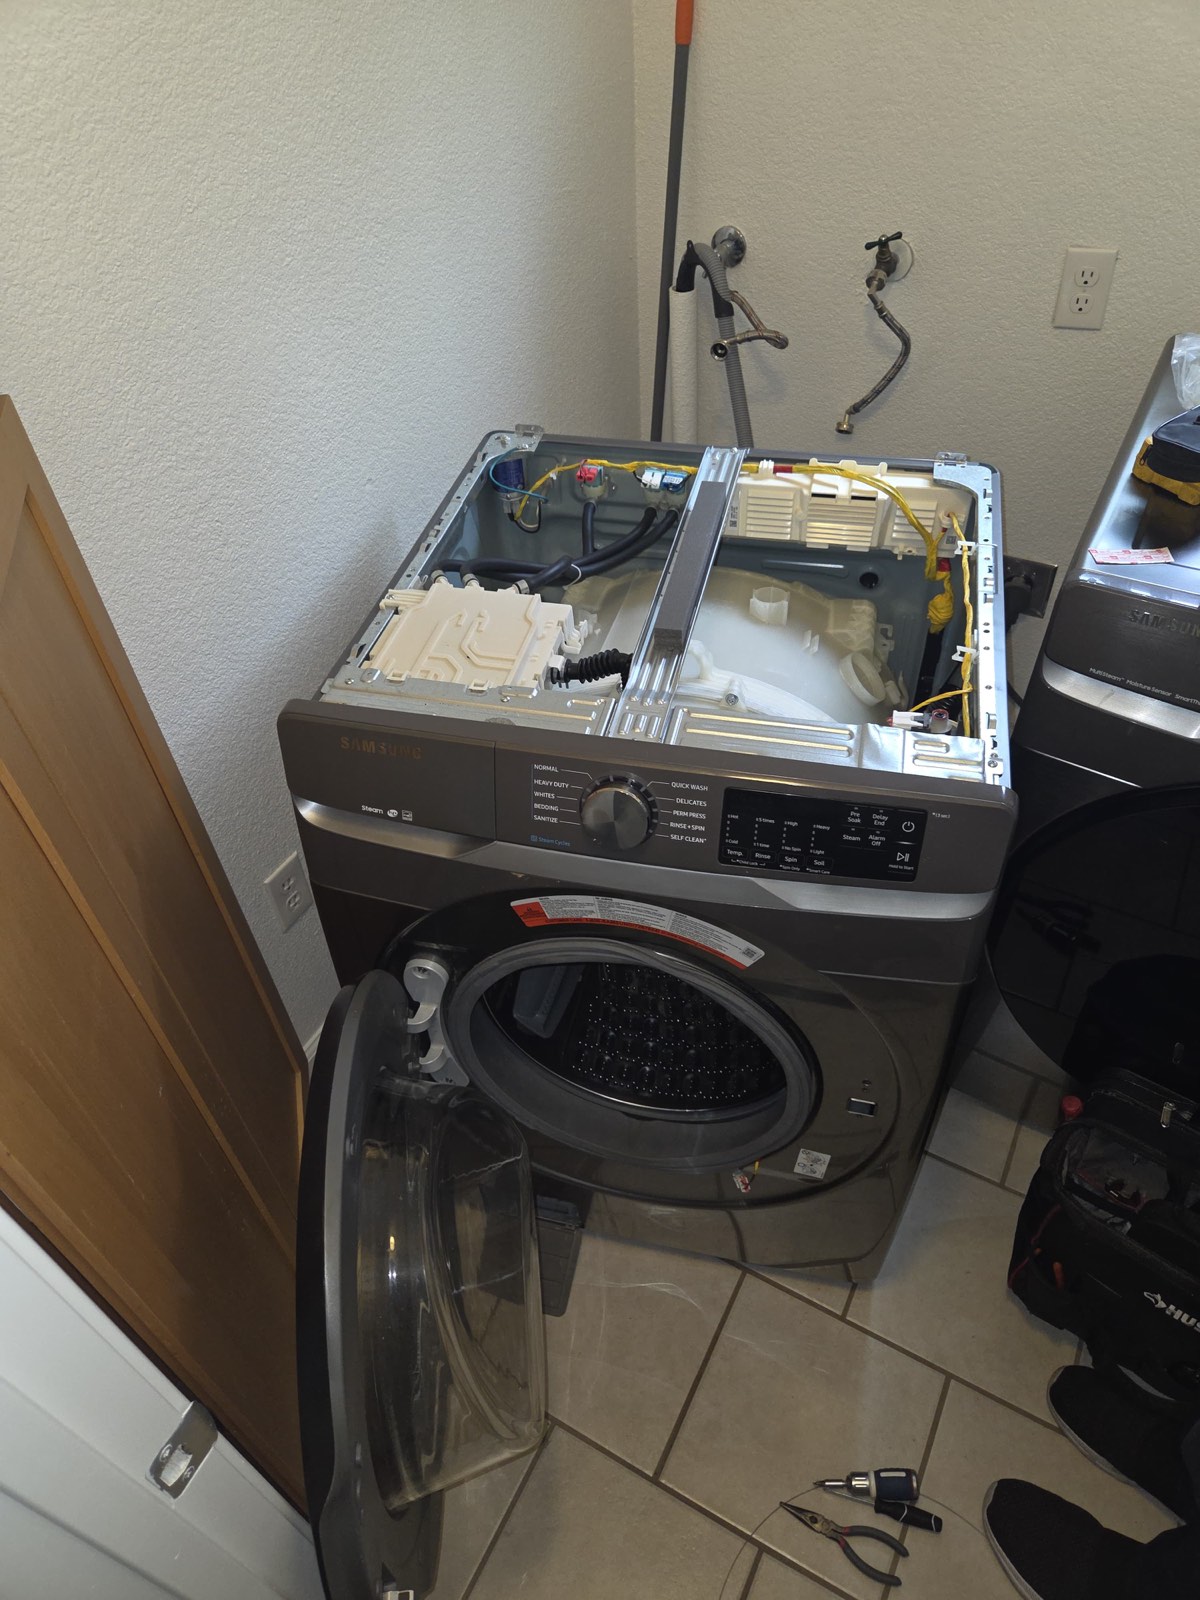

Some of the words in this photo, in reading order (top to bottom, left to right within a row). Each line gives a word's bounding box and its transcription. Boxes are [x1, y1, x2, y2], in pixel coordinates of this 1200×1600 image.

[1126, 680, 1151, 692] Moisture
[1151, 686, 1172, 698] Sensor
[339, 736, 422, 760] SAMSUNG
[534, 764, 559, 773] NORMAL
[534, 779, 553, 787] HEAVY
[554, 781, 570, 789] DUTY
[671, 781, 690, 790] QUICK
[690, 784, 708, 792] WASH
[534, 791, 555, 799] WHITES
[676, 798, 707, 806] DELICATES
[361, 804, 384, 815] Steam
[534, 803, 559, 812] BEDDING
[534, 815, 558, 824] SANITIZE
[689, 812, 706, 820] PRESS
[872, 813, 888, 822] Delay
[538, 836, 554, 844] Steam
[842, 834, 861, 842] Steam
[868, 834, 886, 842] Alarm
[754, 852, 771, 860] Rinse
